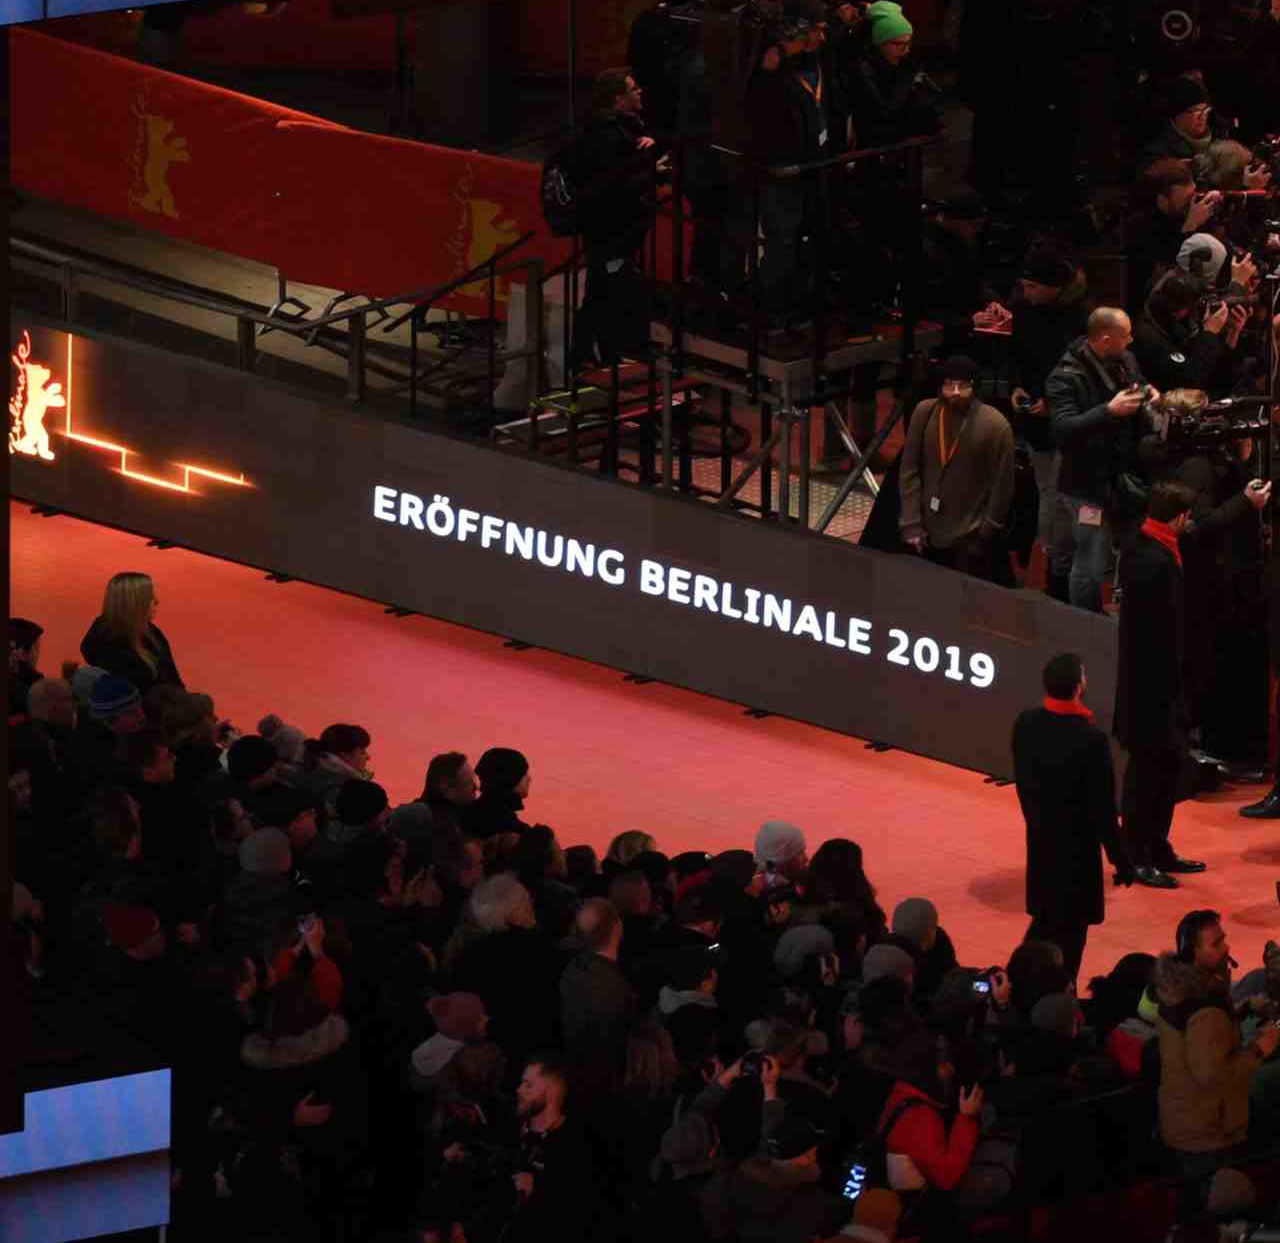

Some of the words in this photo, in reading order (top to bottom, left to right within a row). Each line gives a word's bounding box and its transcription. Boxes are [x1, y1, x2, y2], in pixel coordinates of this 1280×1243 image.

[373, 485, 625, 585] ERÖFFNUNG
[640, 559, 872, 655] BERLINALE
[886, 628, 995, 688] 2019
